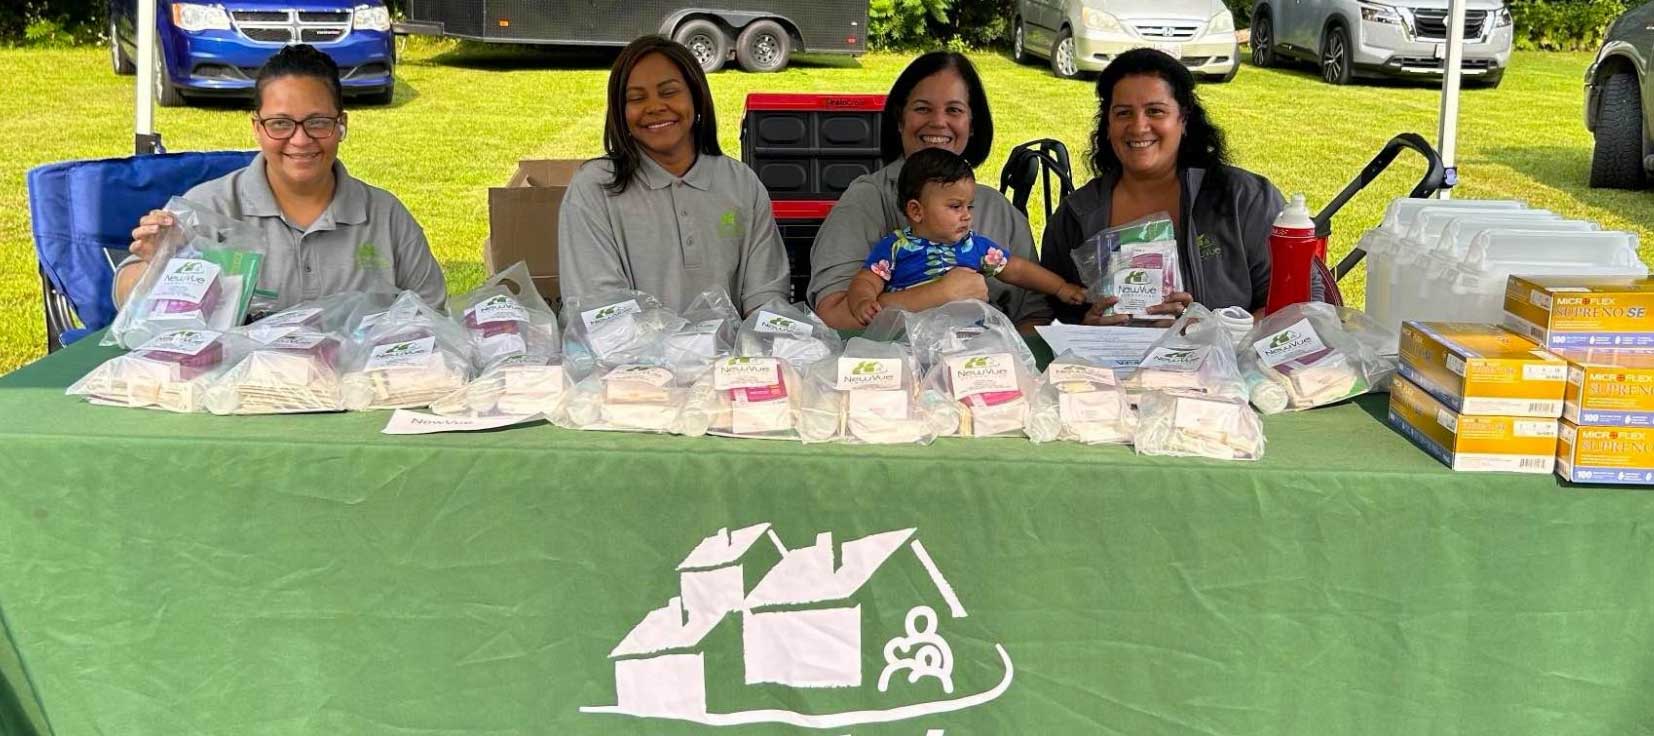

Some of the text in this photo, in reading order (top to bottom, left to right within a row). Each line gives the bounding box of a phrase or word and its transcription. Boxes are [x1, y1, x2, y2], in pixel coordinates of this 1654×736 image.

[1118, 285, 1157, 295] NewVue
[1556, 297, 1616, 306] MICROFLEX
[1557, 306, 1647, 318] SUPRENO SE
[1552, 335, 1566, 344] 100
[1263, 336, 1312, 356] NewVue
[720, 366, 770, 374] NewVue
[957, 367, 1008, 378] NewVue
[843, 374, 894, 383] NewVue
[410, 417, 475, 425] NewVue
[1583, 413, 1600, 423] 100
[1582, 431, 1646, 440] MICROFLEX
[1577, 470, 1593, 479] 100
